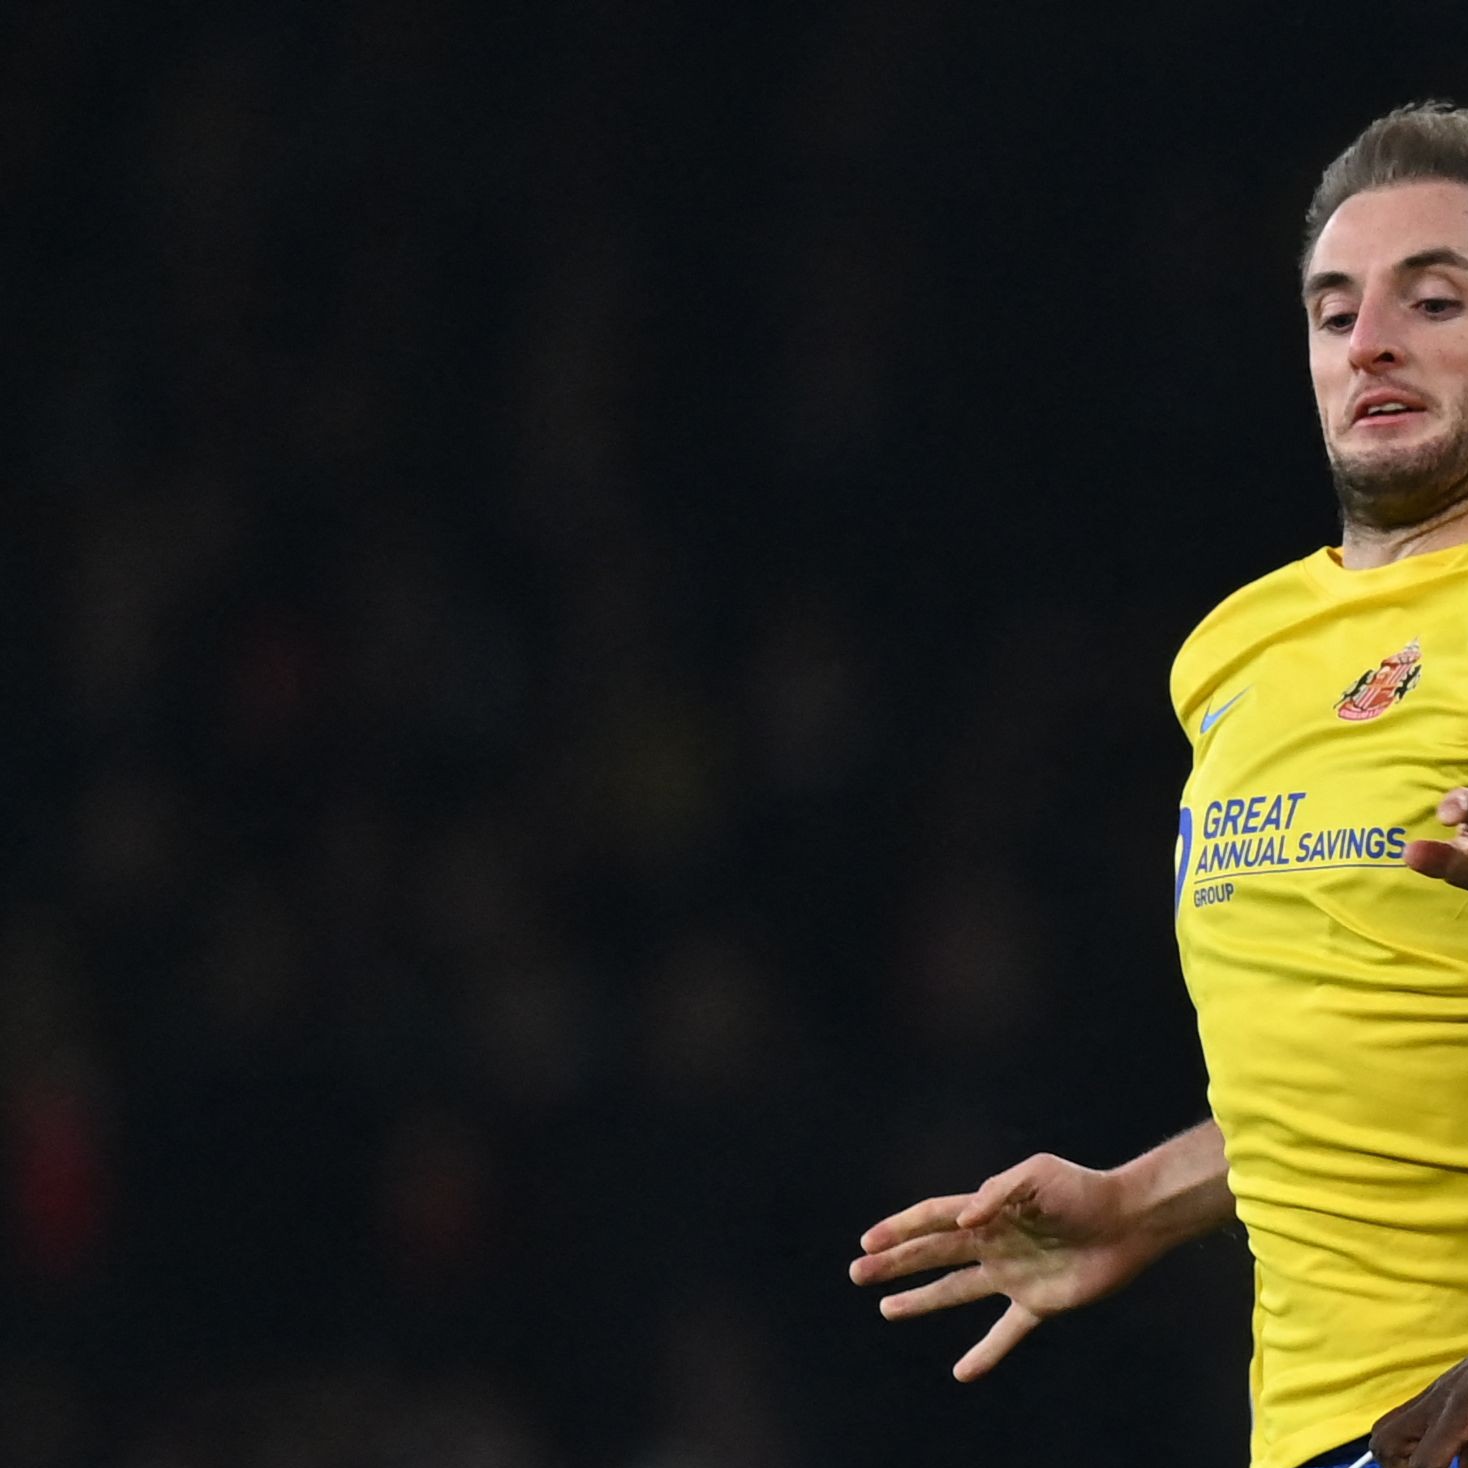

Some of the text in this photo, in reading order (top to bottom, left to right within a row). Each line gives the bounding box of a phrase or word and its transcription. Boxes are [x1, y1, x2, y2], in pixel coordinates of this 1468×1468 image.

[1203, 792, 1307, 840] GREAT
[1194, 835, 1290, 876] ANNUAL
[1295, 826, 1407, 864] SAVINGS
[1193, 882, 1235, 908] GROUP
